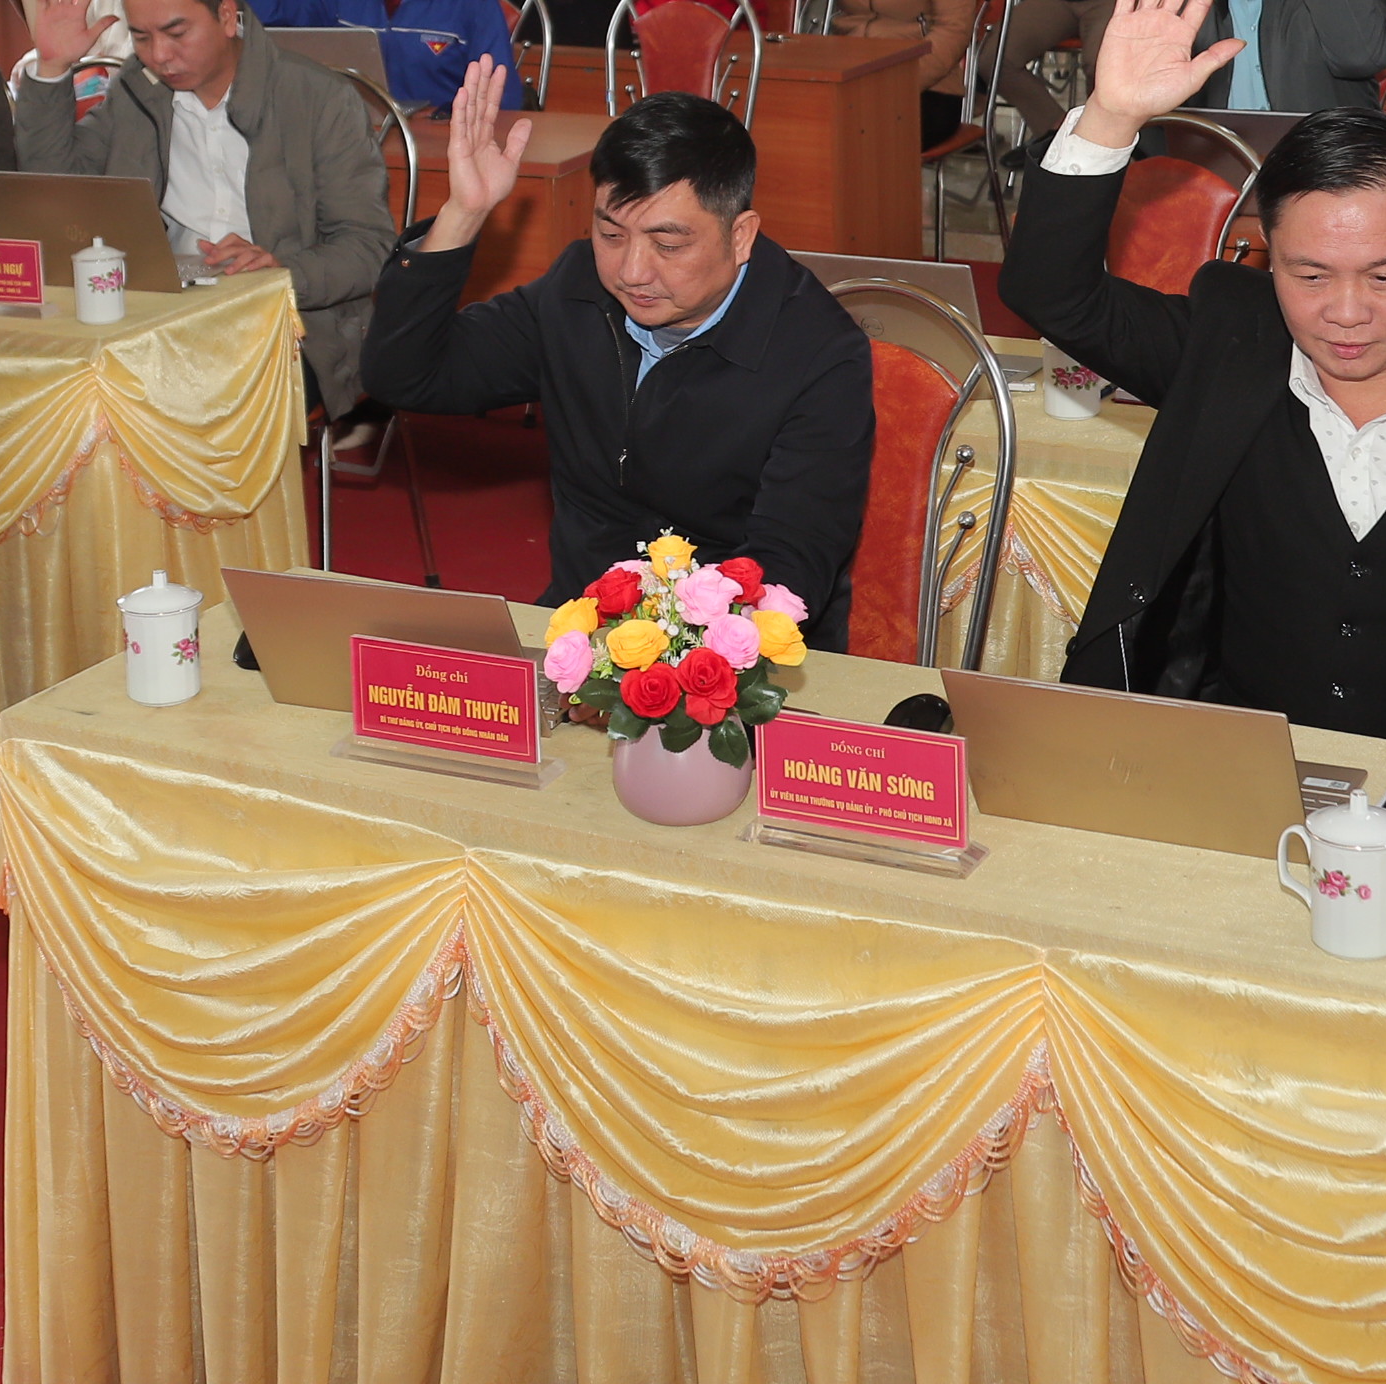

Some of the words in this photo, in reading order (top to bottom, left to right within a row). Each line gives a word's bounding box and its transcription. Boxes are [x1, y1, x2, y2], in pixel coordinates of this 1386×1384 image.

[3, 262, 23, 277] NGỰ
[416, 664, 447, 683] Đồng
[450, 671, 469, 683] chí
[368, 683, 425, 711] NGUYỄN
[428, 691, 461, 716] ĐÀM
[464, 700, 519, 725] THUYÊN
[399, 717, 415, 727] ĐẢNG
[424, 720, 437, 731] CHỦ
[438, 723, 451, 734] TỊCH
[479, 730, 496, 741] NHÂN
[496, 732, 509, 743] DÂN
[830, 740, 863, 756] ĐỒNG
[865, 747, 885, 759] CHÍ
[783, 758, 842, 787] HOÀNG
[846, 767, 882, 793] VĂN
[886, 773, 935, 801] SỨNG
[770, 787, 779, 799] ỦY
[779, 790, 795, 802] VIÊN
[795, 793, 809, 804] BAN
[810, 794, 835, 809] THƯỜNG
[836, 800, 844, 812] VỤ
[845, 801, 863, 814] ĐẢNG
[864, 802, 873, 815] ỦY
[879, 806, 893, 818] PHÓ
[893, 808, 907, 821] CHỦ
[908, 812, 923, 824] TỊCH
[942, 815, 953, 827] XÃ
